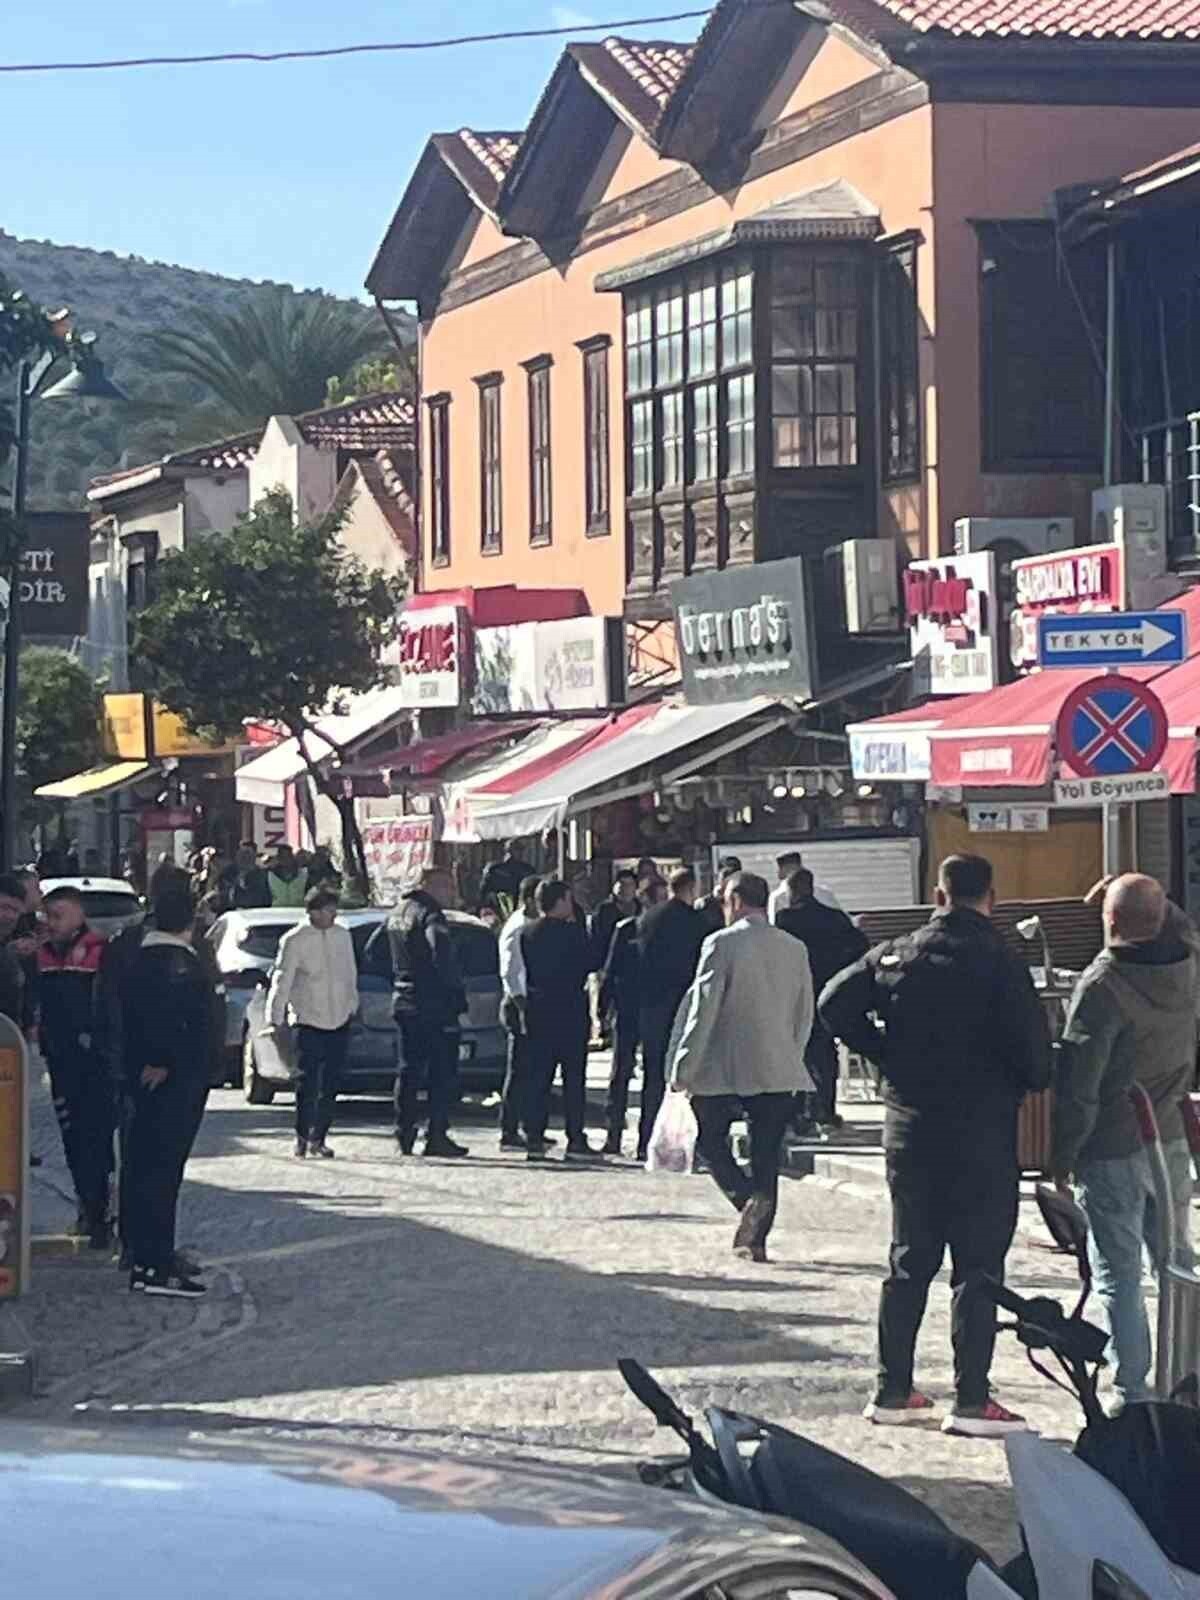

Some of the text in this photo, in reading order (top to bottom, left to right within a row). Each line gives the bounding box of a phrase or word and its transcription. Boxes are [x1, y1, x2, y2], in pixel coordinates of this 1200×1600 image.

[1051, 631, 1144, 649] TEK YÖN
[1060, 777, 1165, 799] Yol Boyunca
